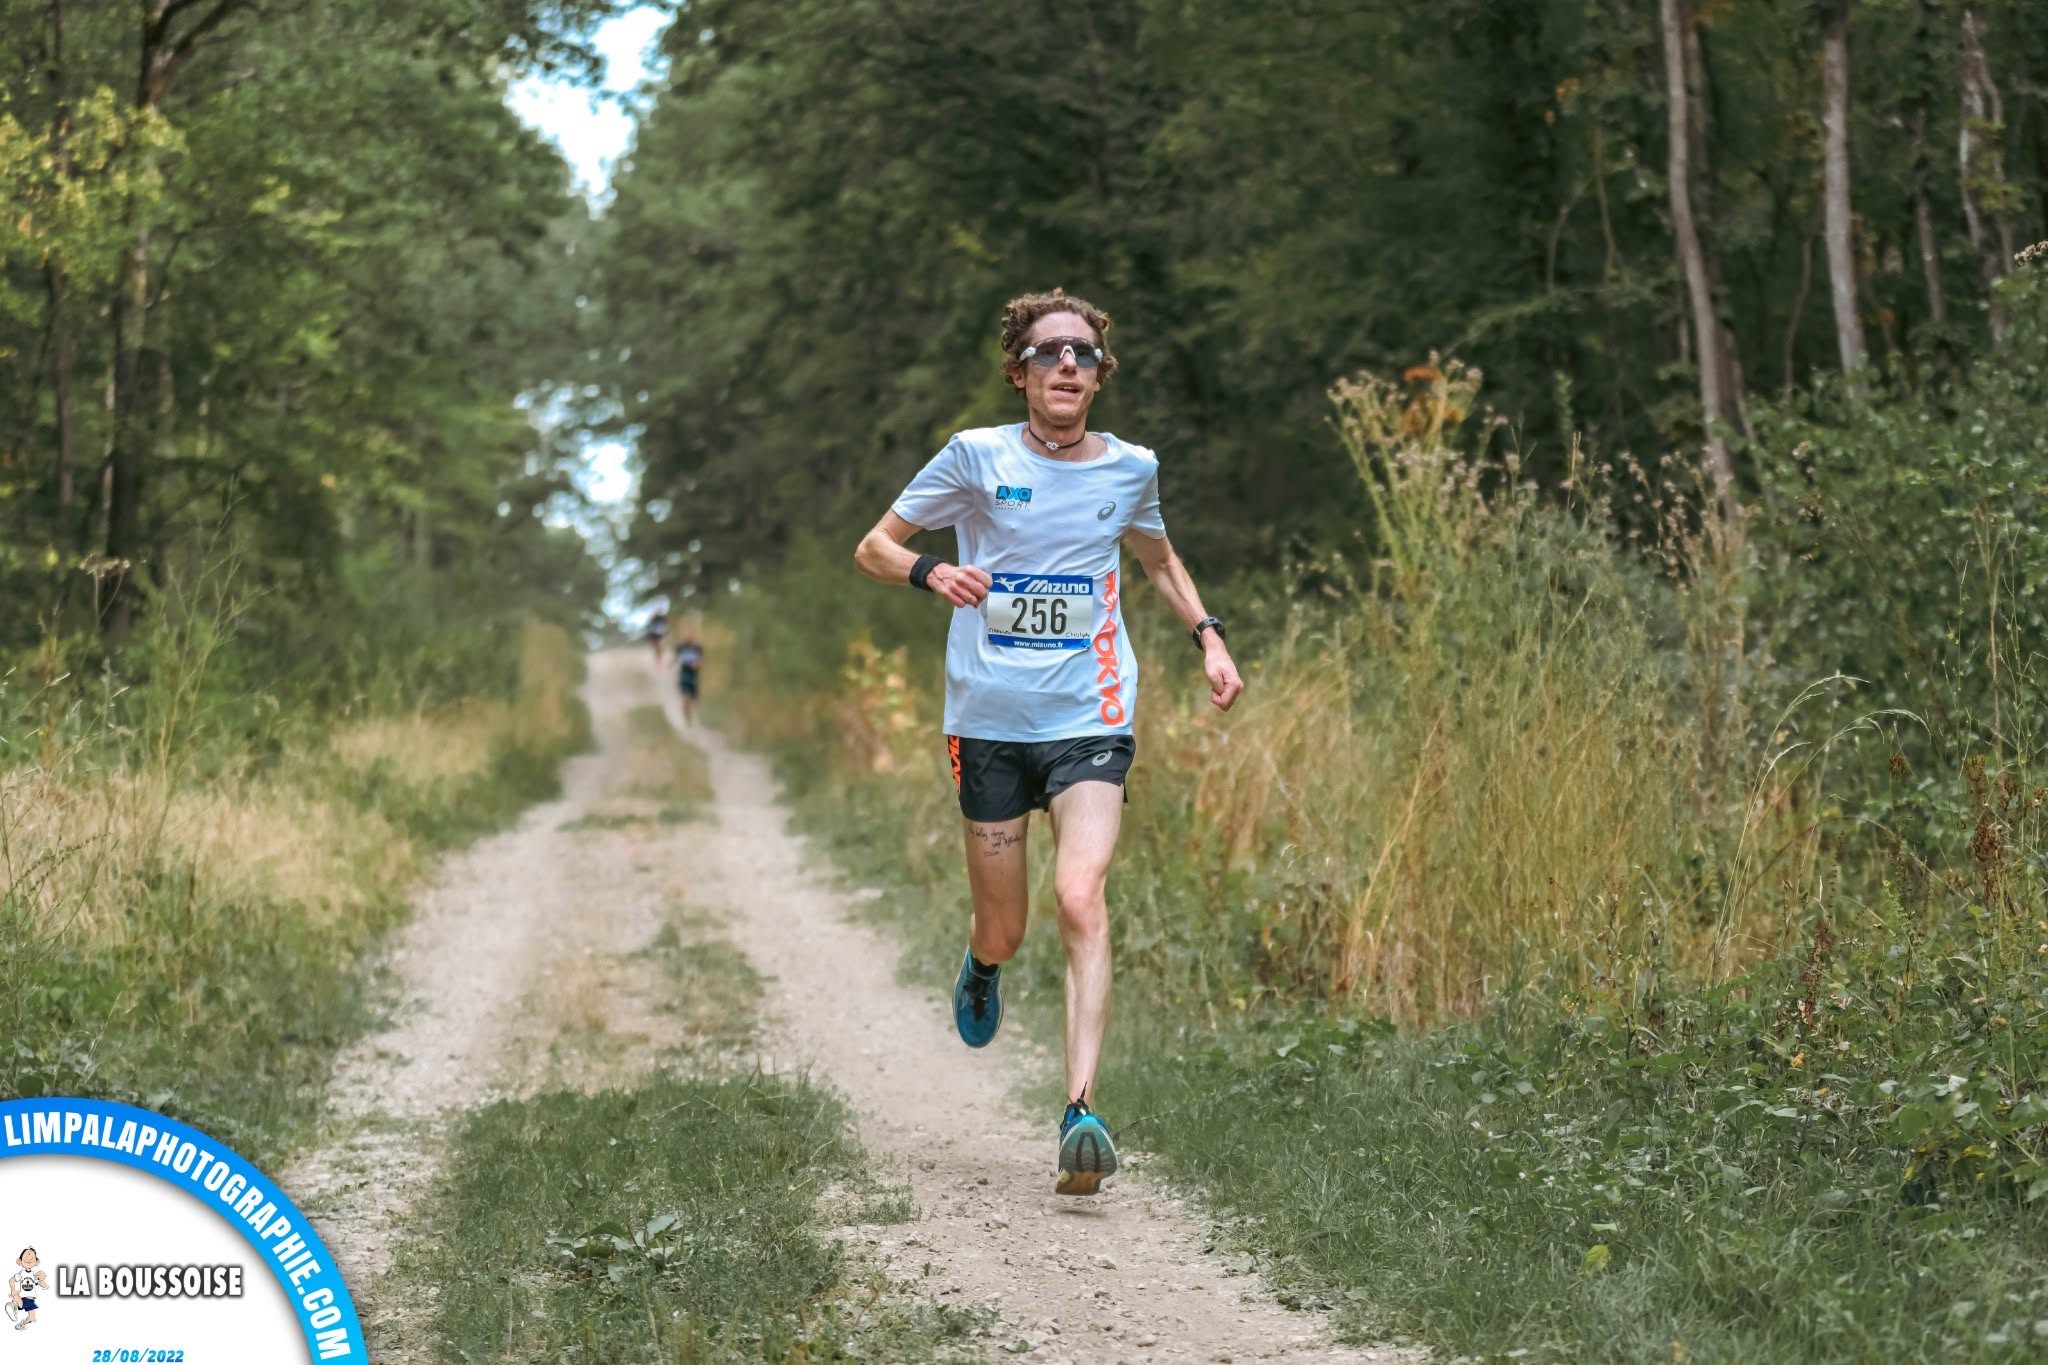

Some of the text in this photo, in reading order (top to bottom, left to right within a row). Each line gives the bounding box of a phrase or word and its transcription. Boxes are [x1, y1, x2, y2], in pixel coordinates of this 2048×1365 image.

[997, 486, 1031, 501] AXO
[995, 500, 1028, 508] SPORT
[1024, 579, 1089, 593] MIZUNO
[1011, 597, 1067, 635] 256
[1014, 640, 1064, 649] www.mizuno.fr
